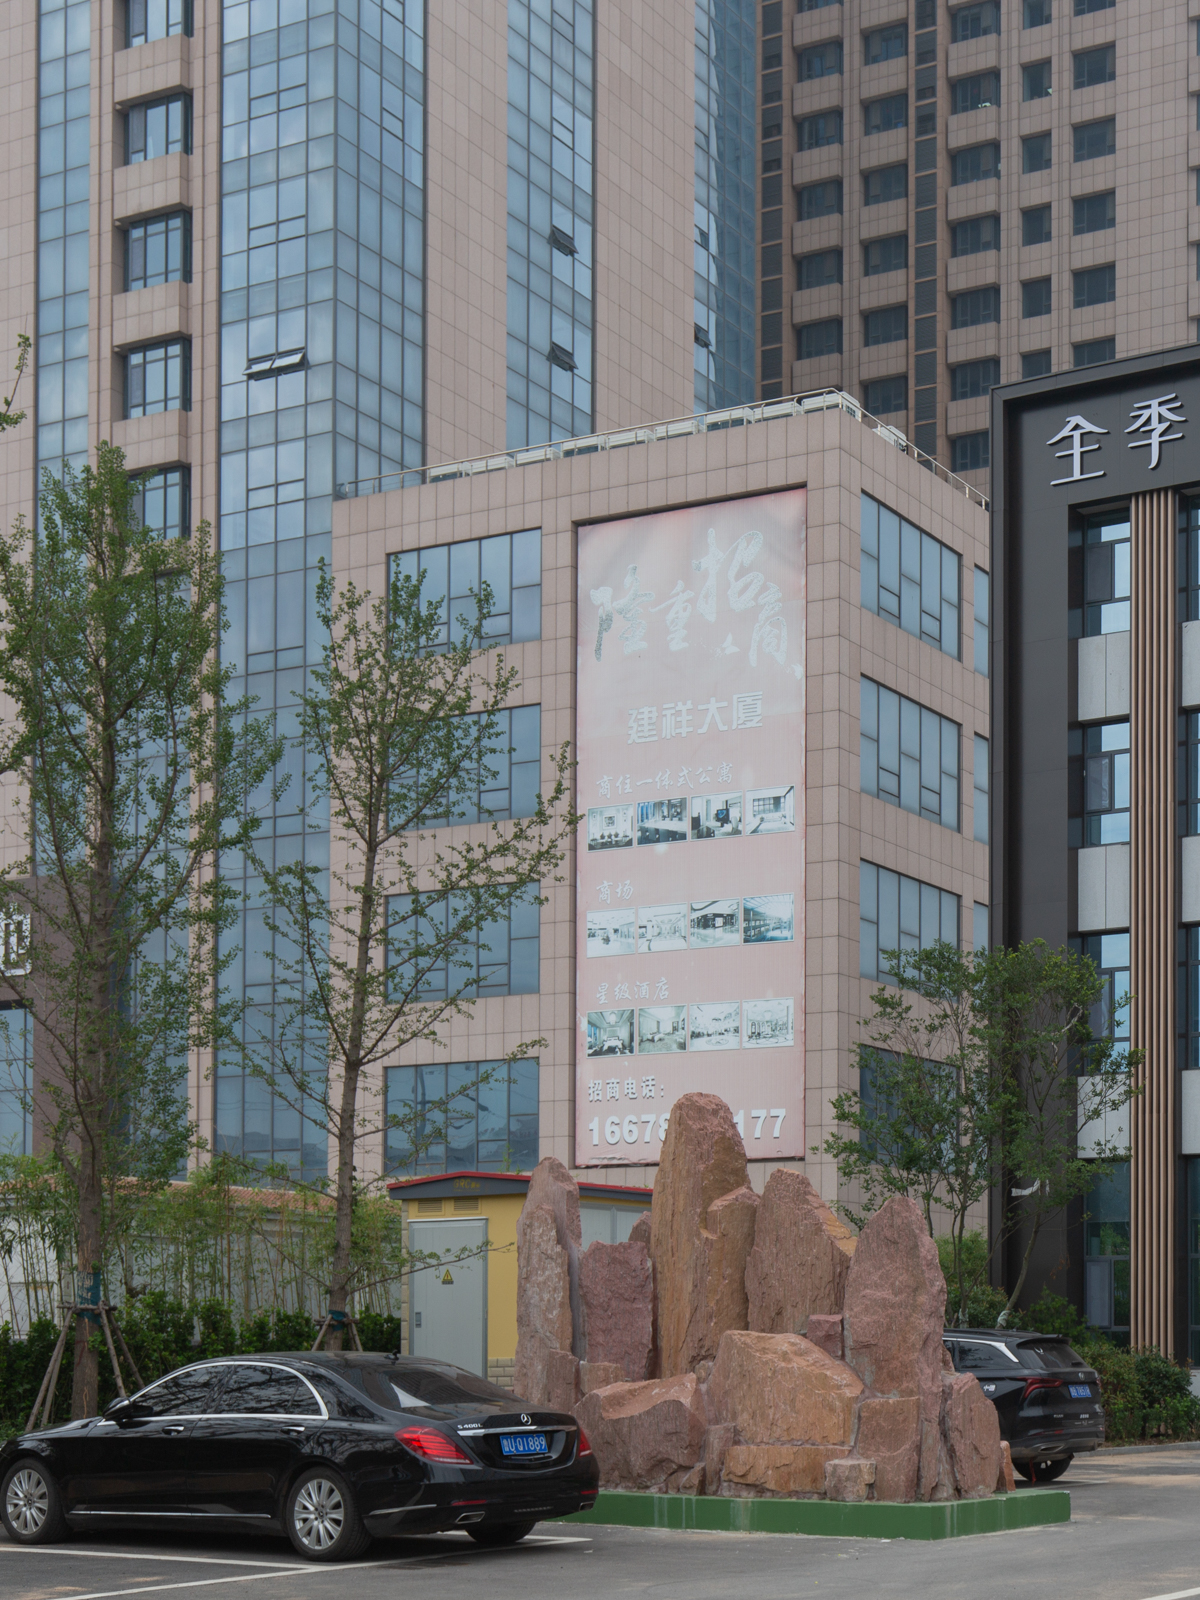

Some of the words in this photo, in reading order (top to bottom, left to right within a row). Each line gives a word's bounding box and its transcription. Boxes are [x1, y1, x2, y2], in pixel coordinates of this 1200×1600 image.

[627, 690, 764, 745] 建祥大厦
[596, 879, 634, 904] 商场
[595, 976, 671, 1005] 星级酒店
[588, 1108, 787, 1146] 16678177
